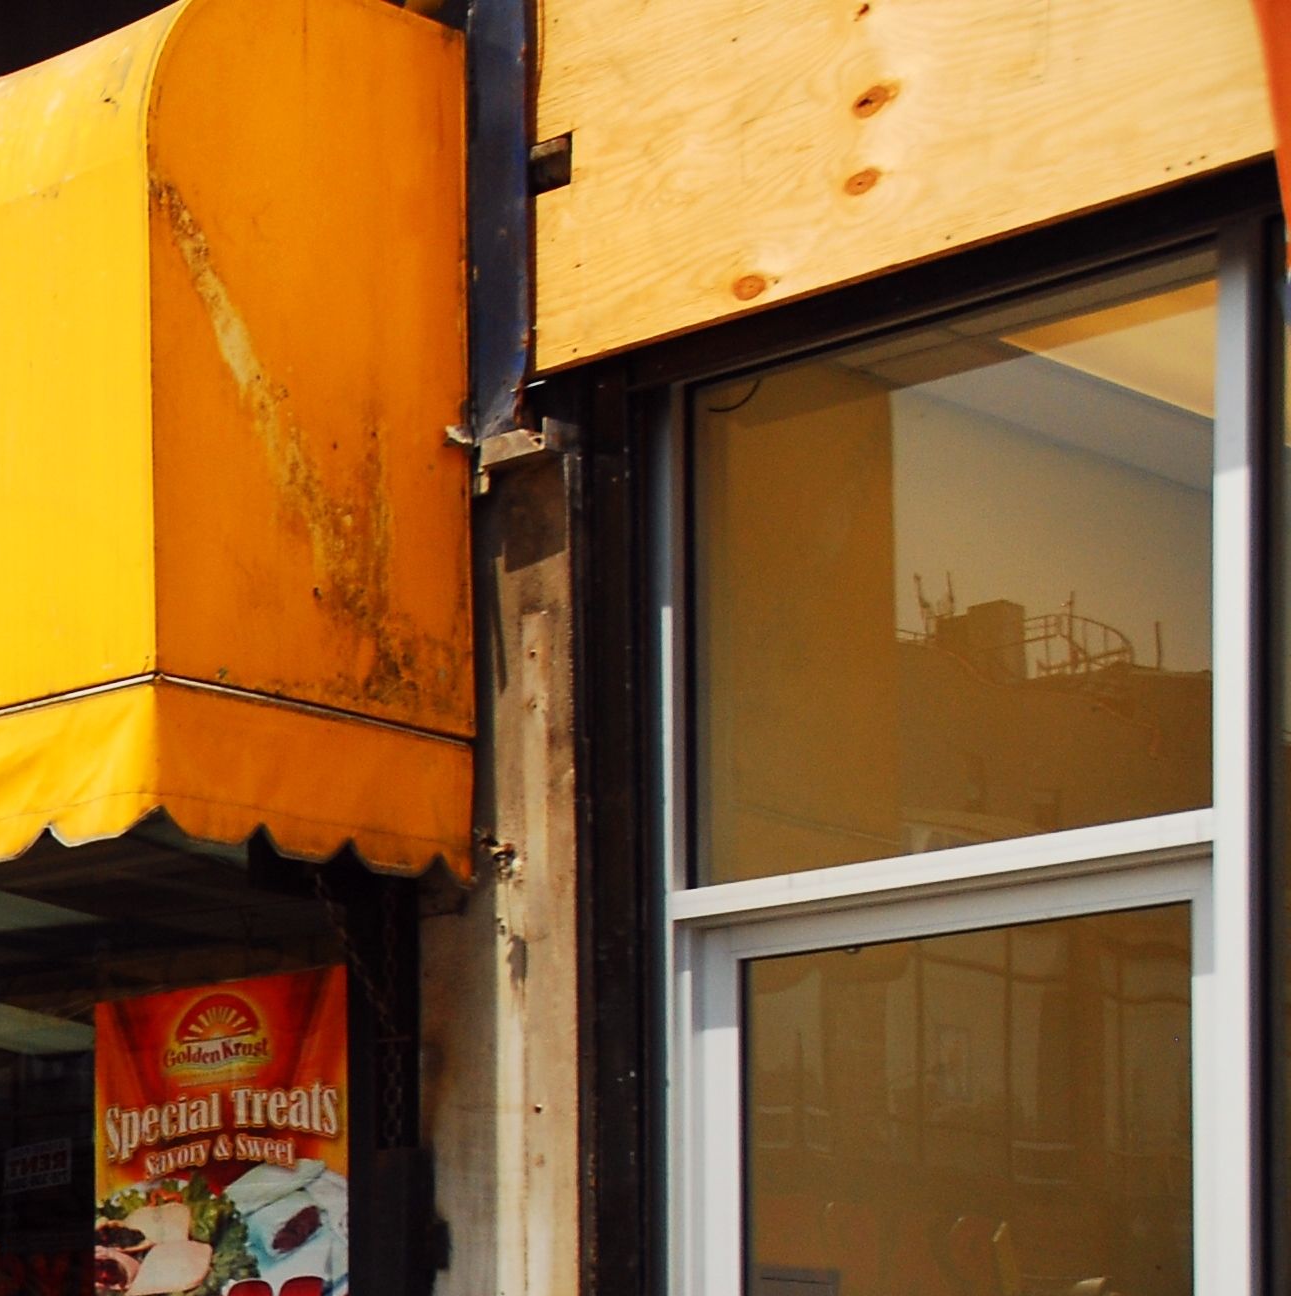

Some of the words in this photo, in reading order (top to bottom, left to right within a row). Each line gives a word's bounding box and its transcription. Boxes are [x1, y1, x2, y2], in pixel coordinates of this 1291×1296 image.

[163, 1043, 220, 1069] Golden
[222, 1036, 269, 1059] Krust
[105, 1092, 221, 1160] Special
[232, 1081, 338, 1136] Treats
[146, 1140, 210, 1179] Savory
[214, 1135, 232, 1160] &
[235, 1134, 296, 1168] Sweet
